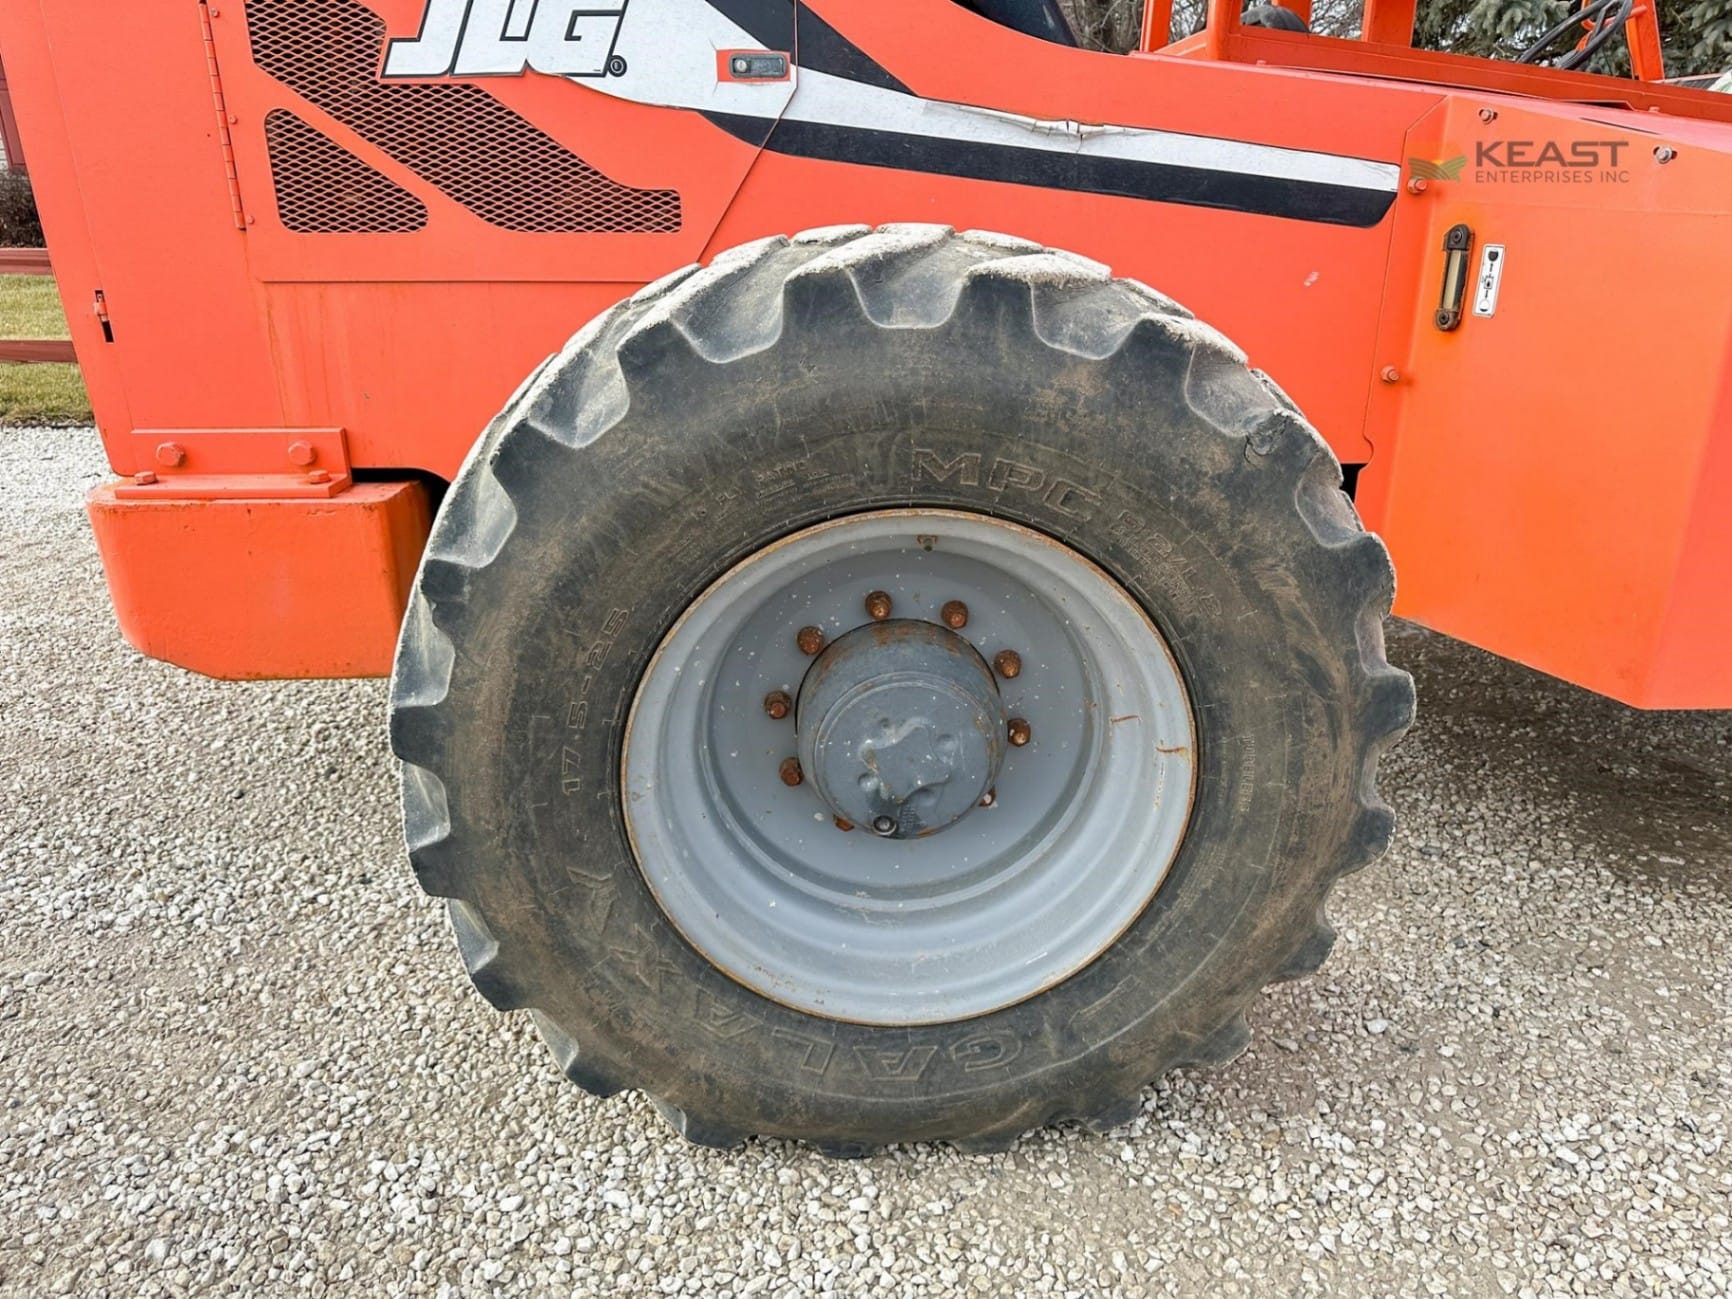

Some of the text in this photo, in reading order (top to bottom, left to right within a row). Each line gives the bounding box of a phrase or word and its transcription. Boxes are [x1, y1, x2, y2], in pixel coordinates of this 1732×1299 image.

[380, 0, 628, 78] JLG
[911, 448, 1100, 520] MPC
[561, 607, 629, 796] 17.5-25
[566, 866, 1021, 1081] GALAXY
